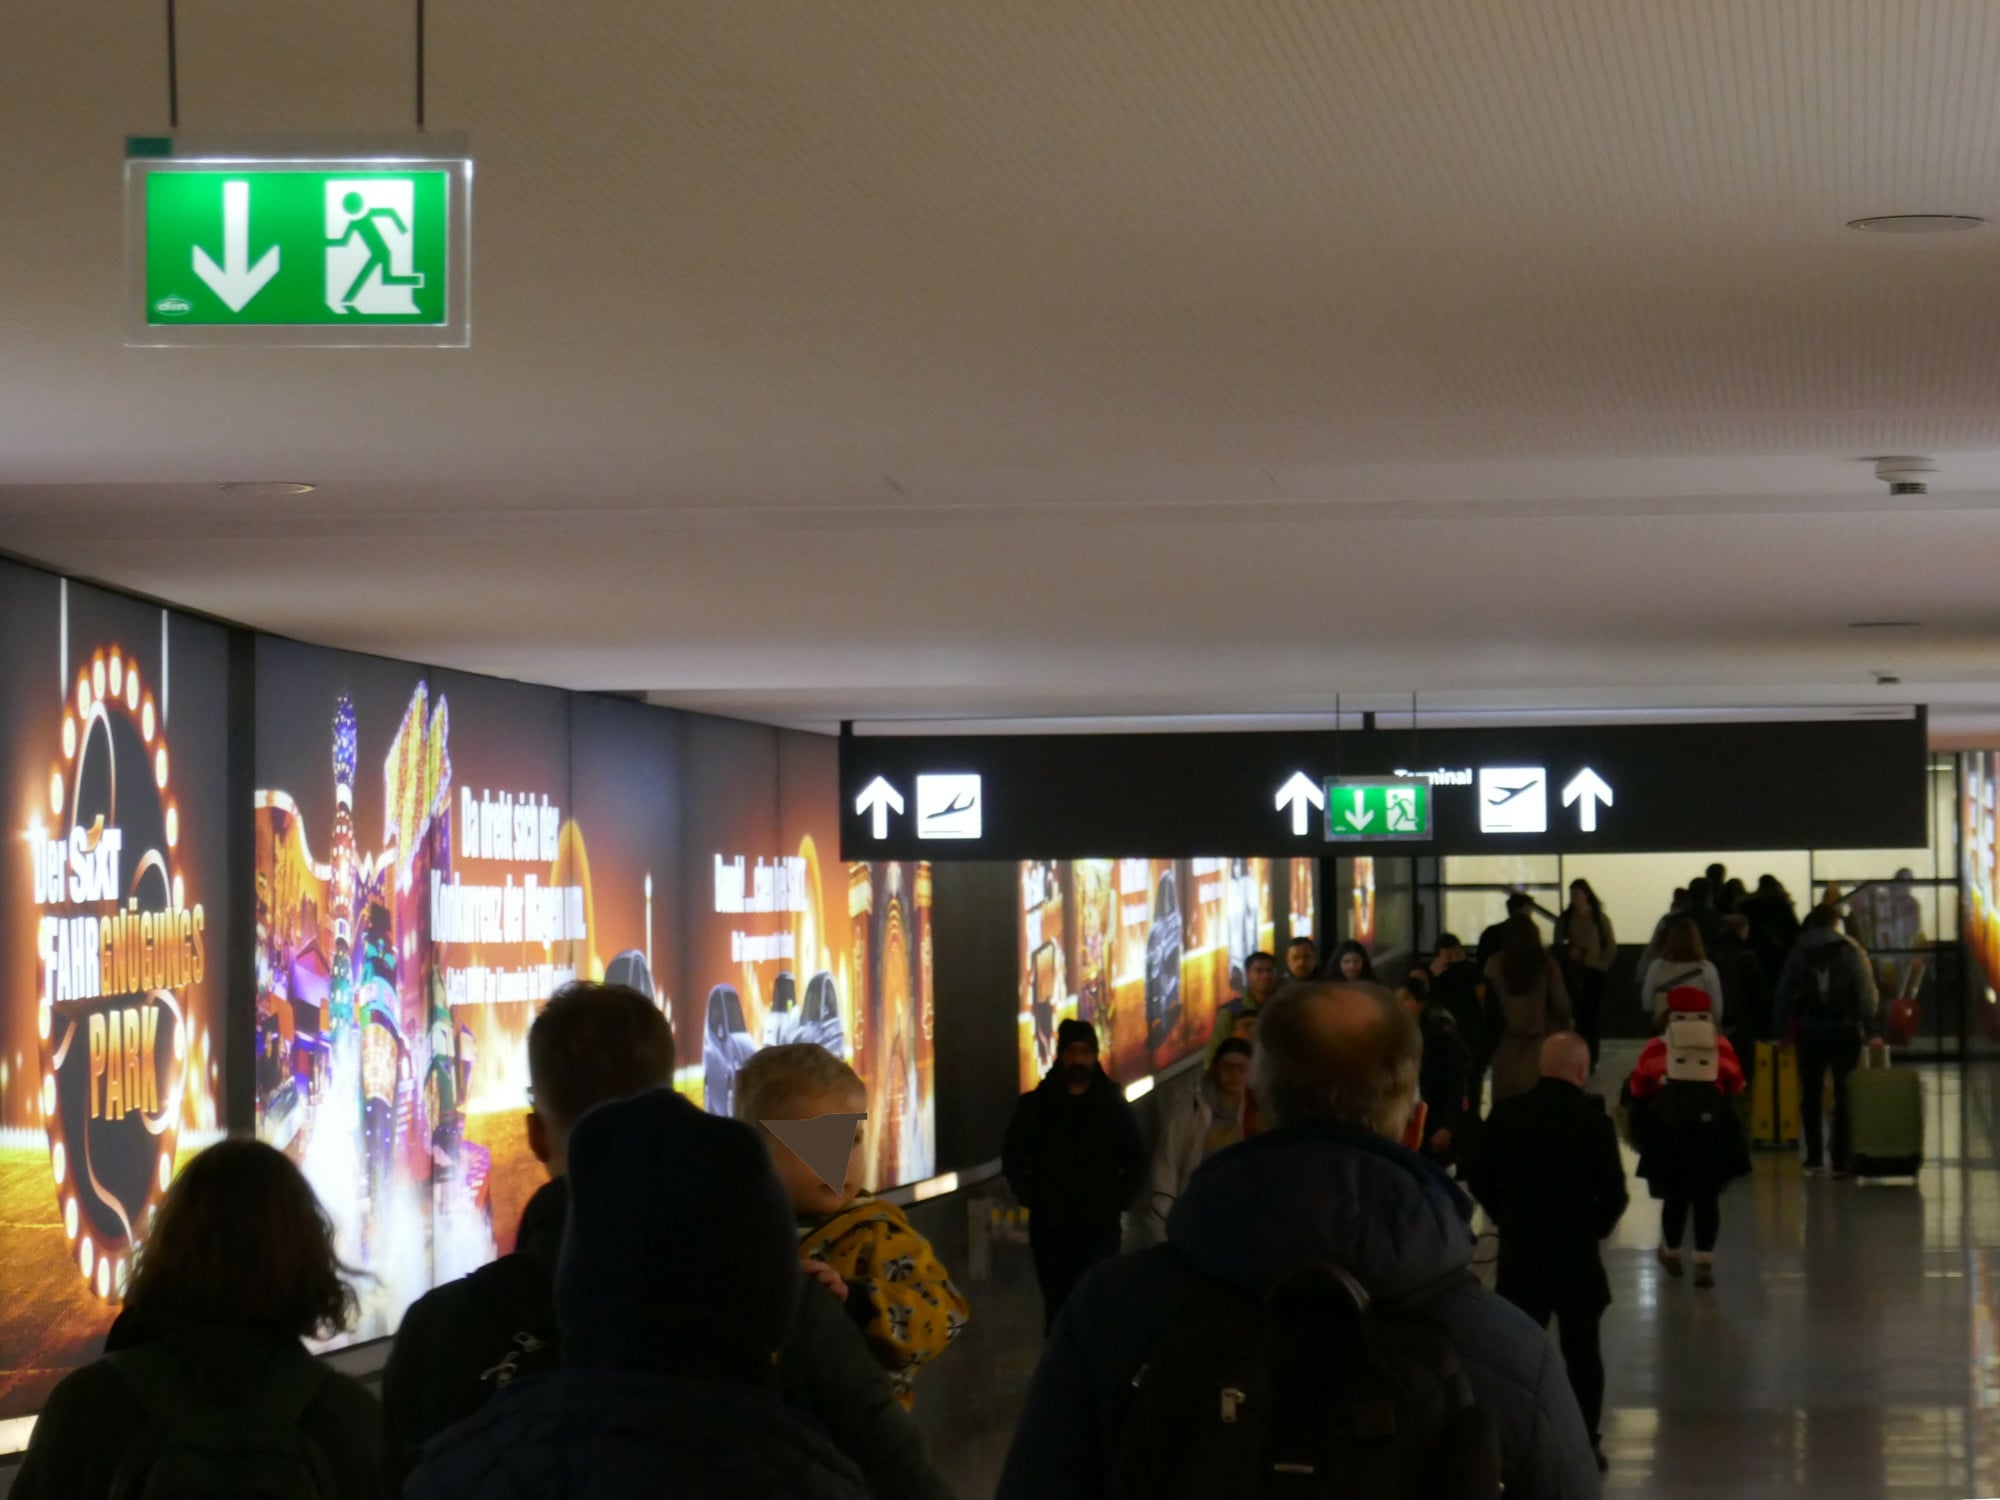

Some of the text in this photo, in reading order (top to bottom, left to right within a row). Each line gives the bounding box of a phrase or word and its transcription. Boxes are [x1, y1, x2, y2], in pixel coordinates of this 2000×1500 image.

[1393, 768, 1473, 785] Tminal
[461, 786, 479, 858] Da
[32, 830, 67, 904] Der
[89, 1005, 160, 1121] PARK
